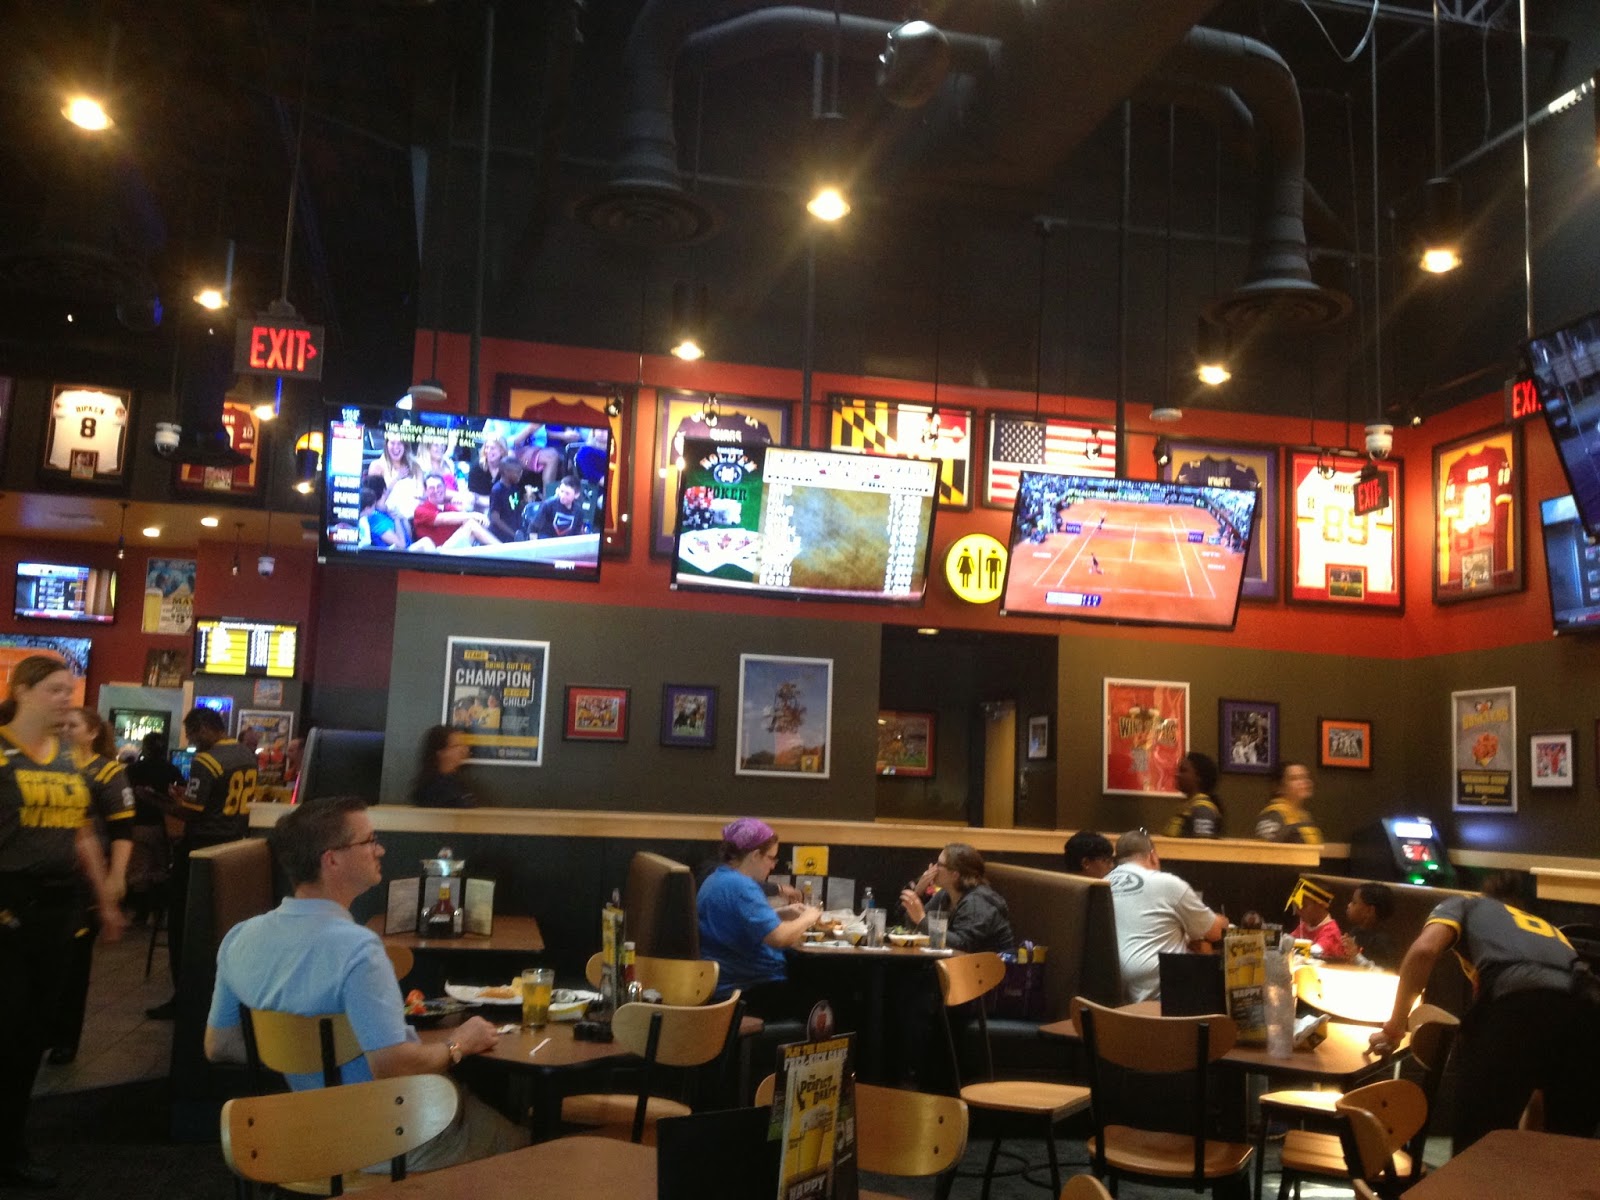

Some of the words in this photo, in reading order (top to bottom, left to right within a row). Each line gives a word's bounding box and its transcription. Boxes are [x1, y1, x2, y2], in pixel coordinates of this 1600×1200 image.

[250, 326, 311, 371] EXIT
[1513, 380, 1542, 418] EXI
[80, 417, 97, 439] 8
[706, 485, 748, 501] POKER
[1357, 479, 1379, 512] EXIT
[1322, 504, 1369, 546] 89
[455, 668, 532, 688] CHAMPION
[503, 696, 527, 708] CHILD
[223, 769, 258, 816] 82
[801, 1075, 833, 1094] PERFECT
[813, 1085, 837, 1105] DRAFT
[788, 1174, 827, 1200] HAPPY
